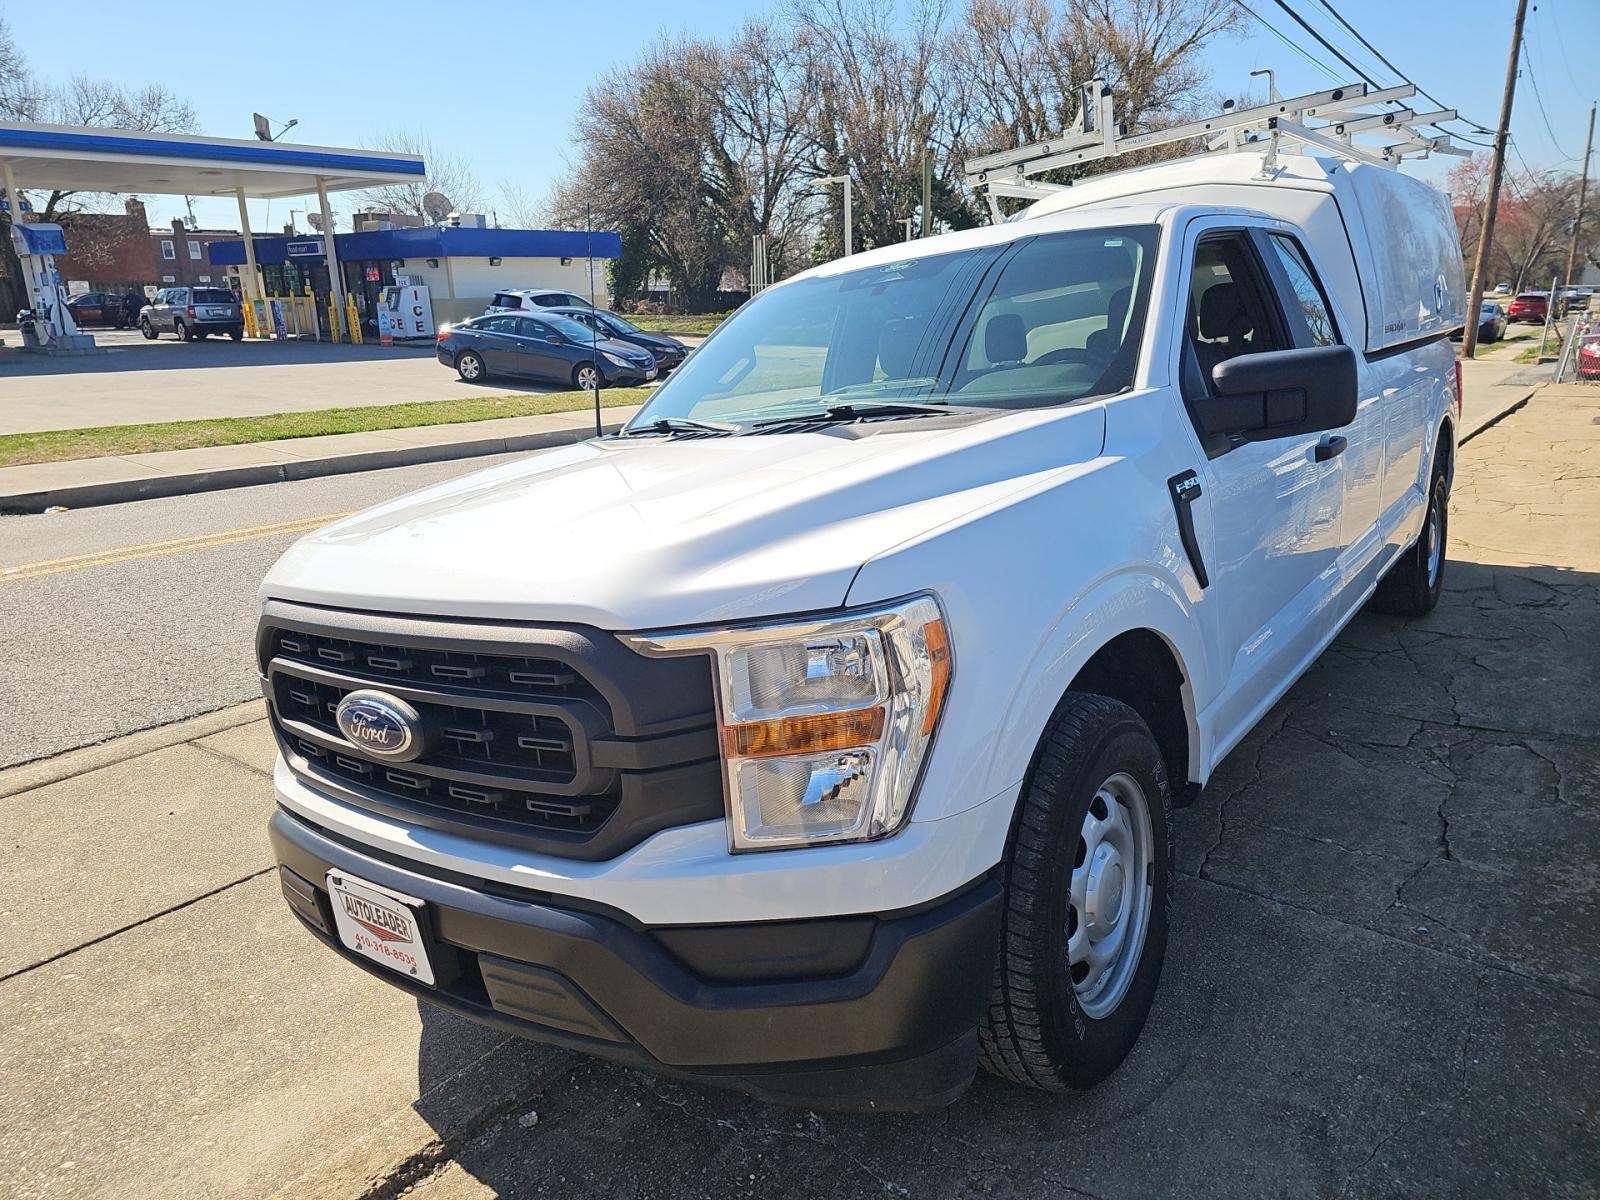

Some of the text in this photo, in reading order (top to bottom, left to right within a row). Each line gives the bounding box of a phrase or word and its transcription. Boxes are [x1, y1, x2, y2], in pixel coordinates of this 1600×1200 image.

[413, 290, 425, 332] ICE
[350, 711, 389, 744] Ford
[344, 895, 411, 939] AUTOLEADER
